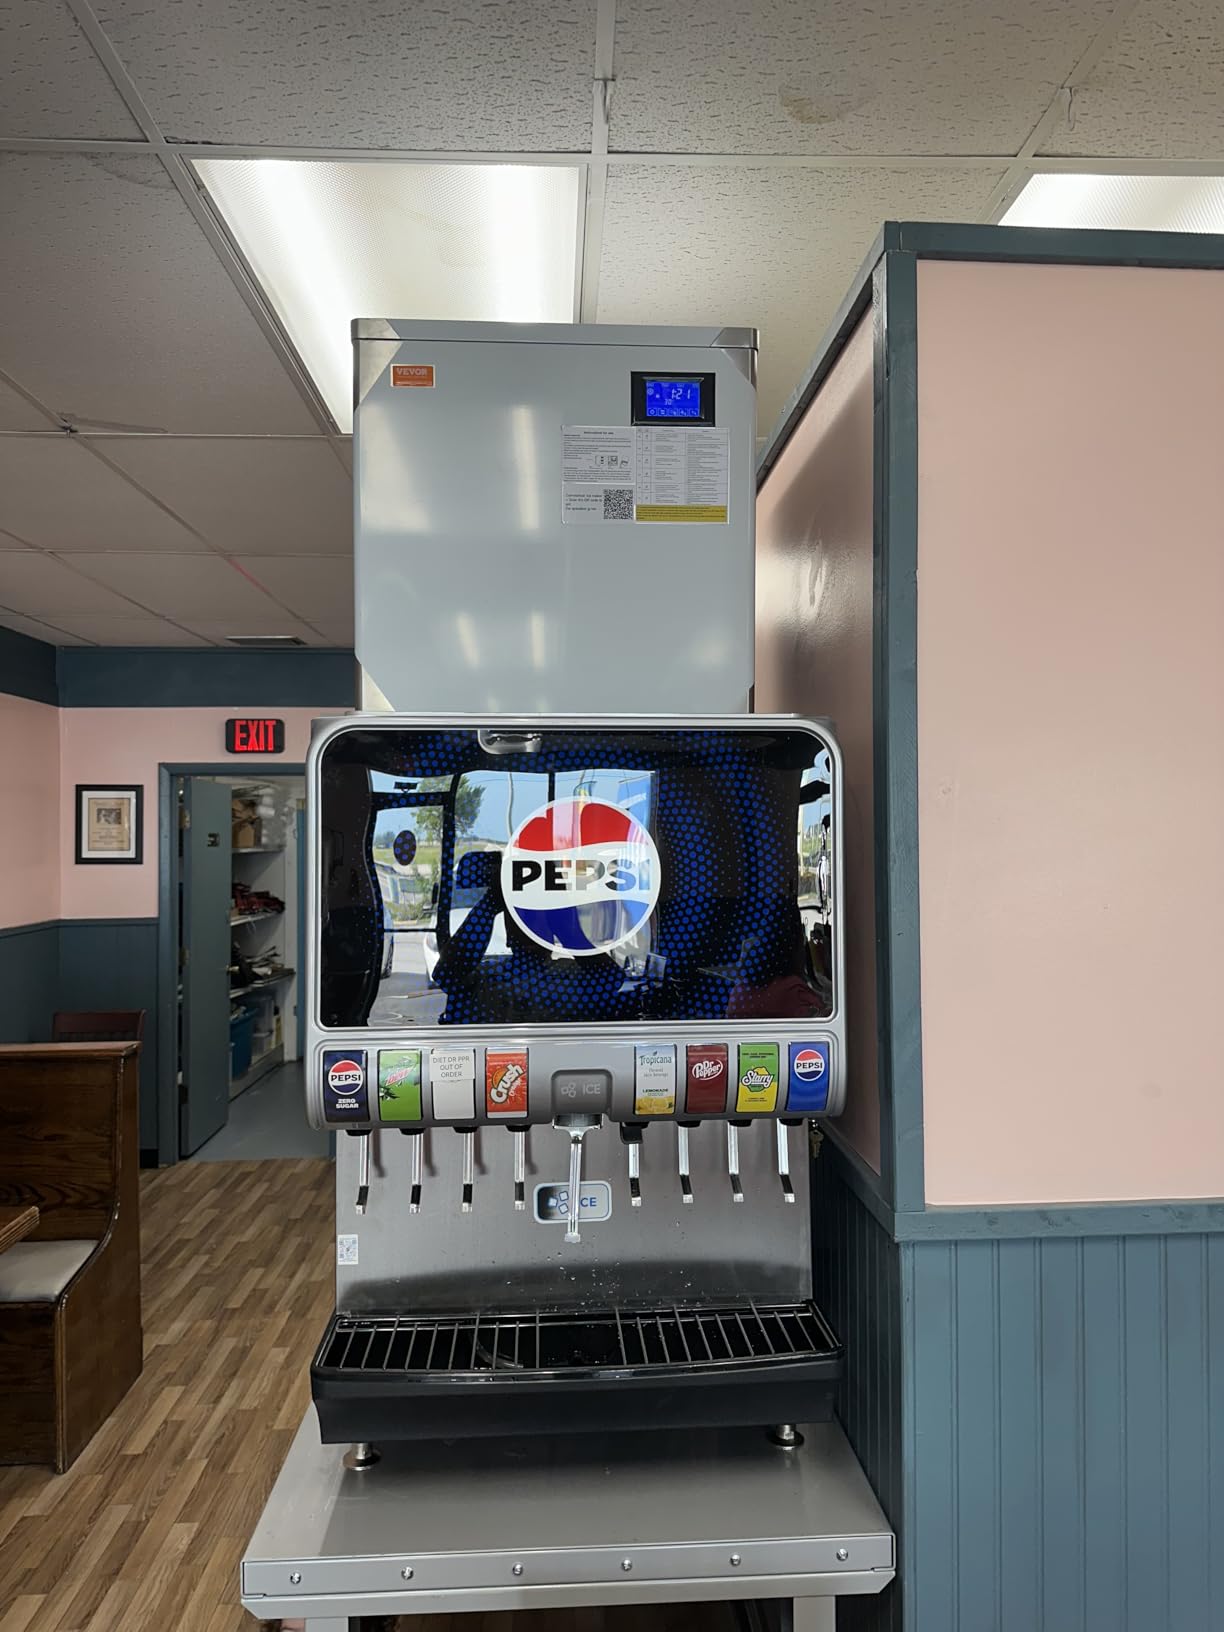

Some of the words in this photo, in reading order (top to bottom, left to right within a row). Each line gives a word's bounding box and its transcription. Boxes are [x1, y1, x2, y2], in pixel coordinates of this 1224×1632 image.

[396, 367, 428, 376] VEVOR
[235, 720, 276, 752] EXIT
[511, 859, 651, 892] PEPSI
[639, 1055, 672, 1066] Tropicana
[702, 1060, 714, 1069] Dr
[695, 1062, 721, 1079] Pepper
[330, 1074, 361, 1082] PEPSI
[490, 1063, 525, 1104] Crush
[741, 1070, 774, 1088] Starry
[582, 1083, 601, 1096] ICE
[579, 1197, 597, 1207] CE
